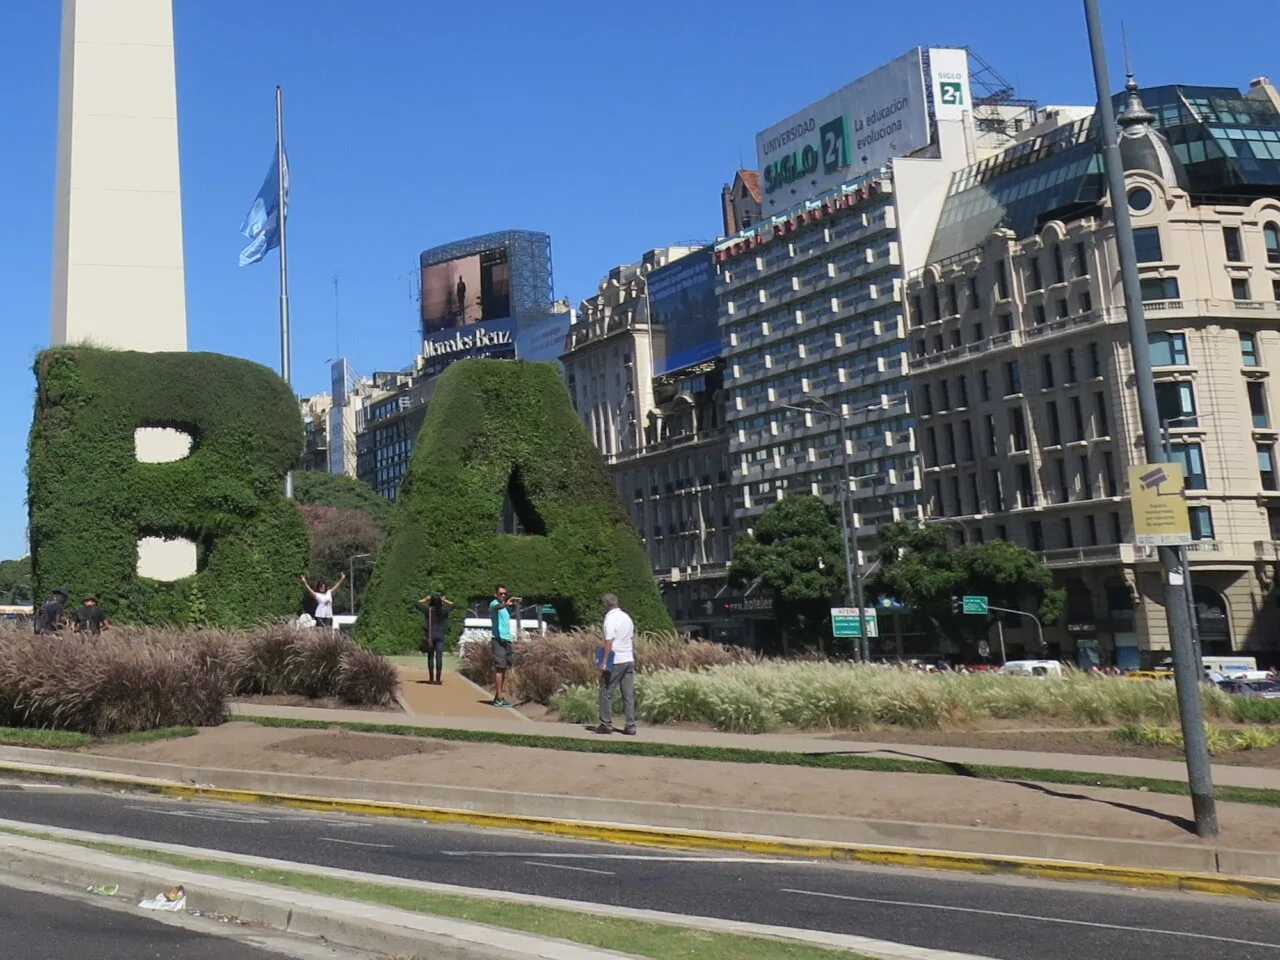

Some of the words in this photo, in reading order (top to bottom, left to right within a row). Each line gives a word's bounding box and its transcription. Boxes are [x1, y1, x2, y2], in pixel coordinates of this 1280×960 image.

[937, 72, 962, 80] SIGLO
[943, 85, 961, 105] 21
[854, 119, 864, 133] La
[866, 96, 909, 127] educación
[763, 118, 816, 155] UNIVERSIDAD
[856, 119, 902, 150] evoluciona
[764, 144, 818, 194] SIGLO
[824, 130, 844, 168] 21
[423, 327, 513, 359] Mercedes-Benz
